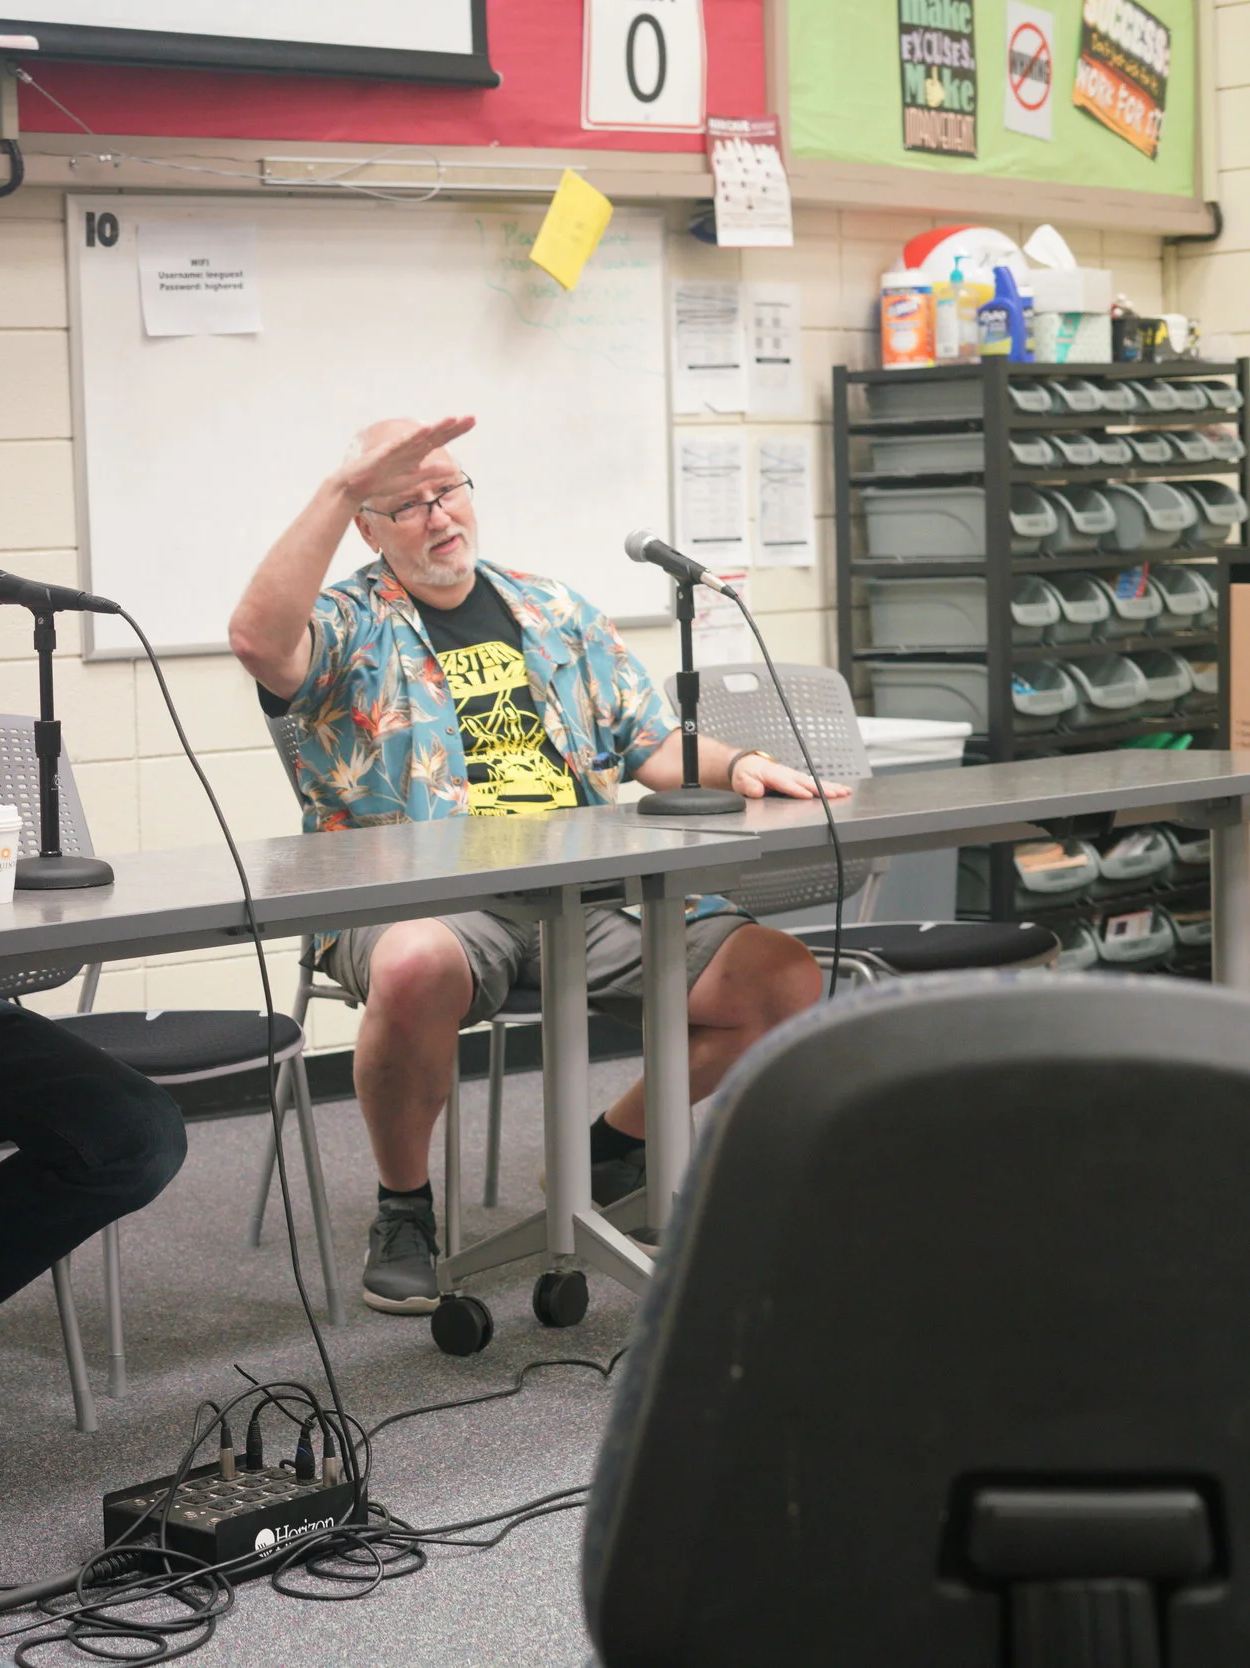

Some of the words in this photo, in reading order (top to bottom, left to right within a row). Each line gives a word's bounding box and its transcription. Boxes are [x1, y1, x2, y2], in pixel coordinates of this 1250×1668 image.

[626, 13, 666, 103] 0
[901, 29, 975, 70] EXCUSES.
[904, 62, 975, 112] Mke
[437, 643, 521, 675] EASTERN
[468, 806, 507, 817] AYTOWN
